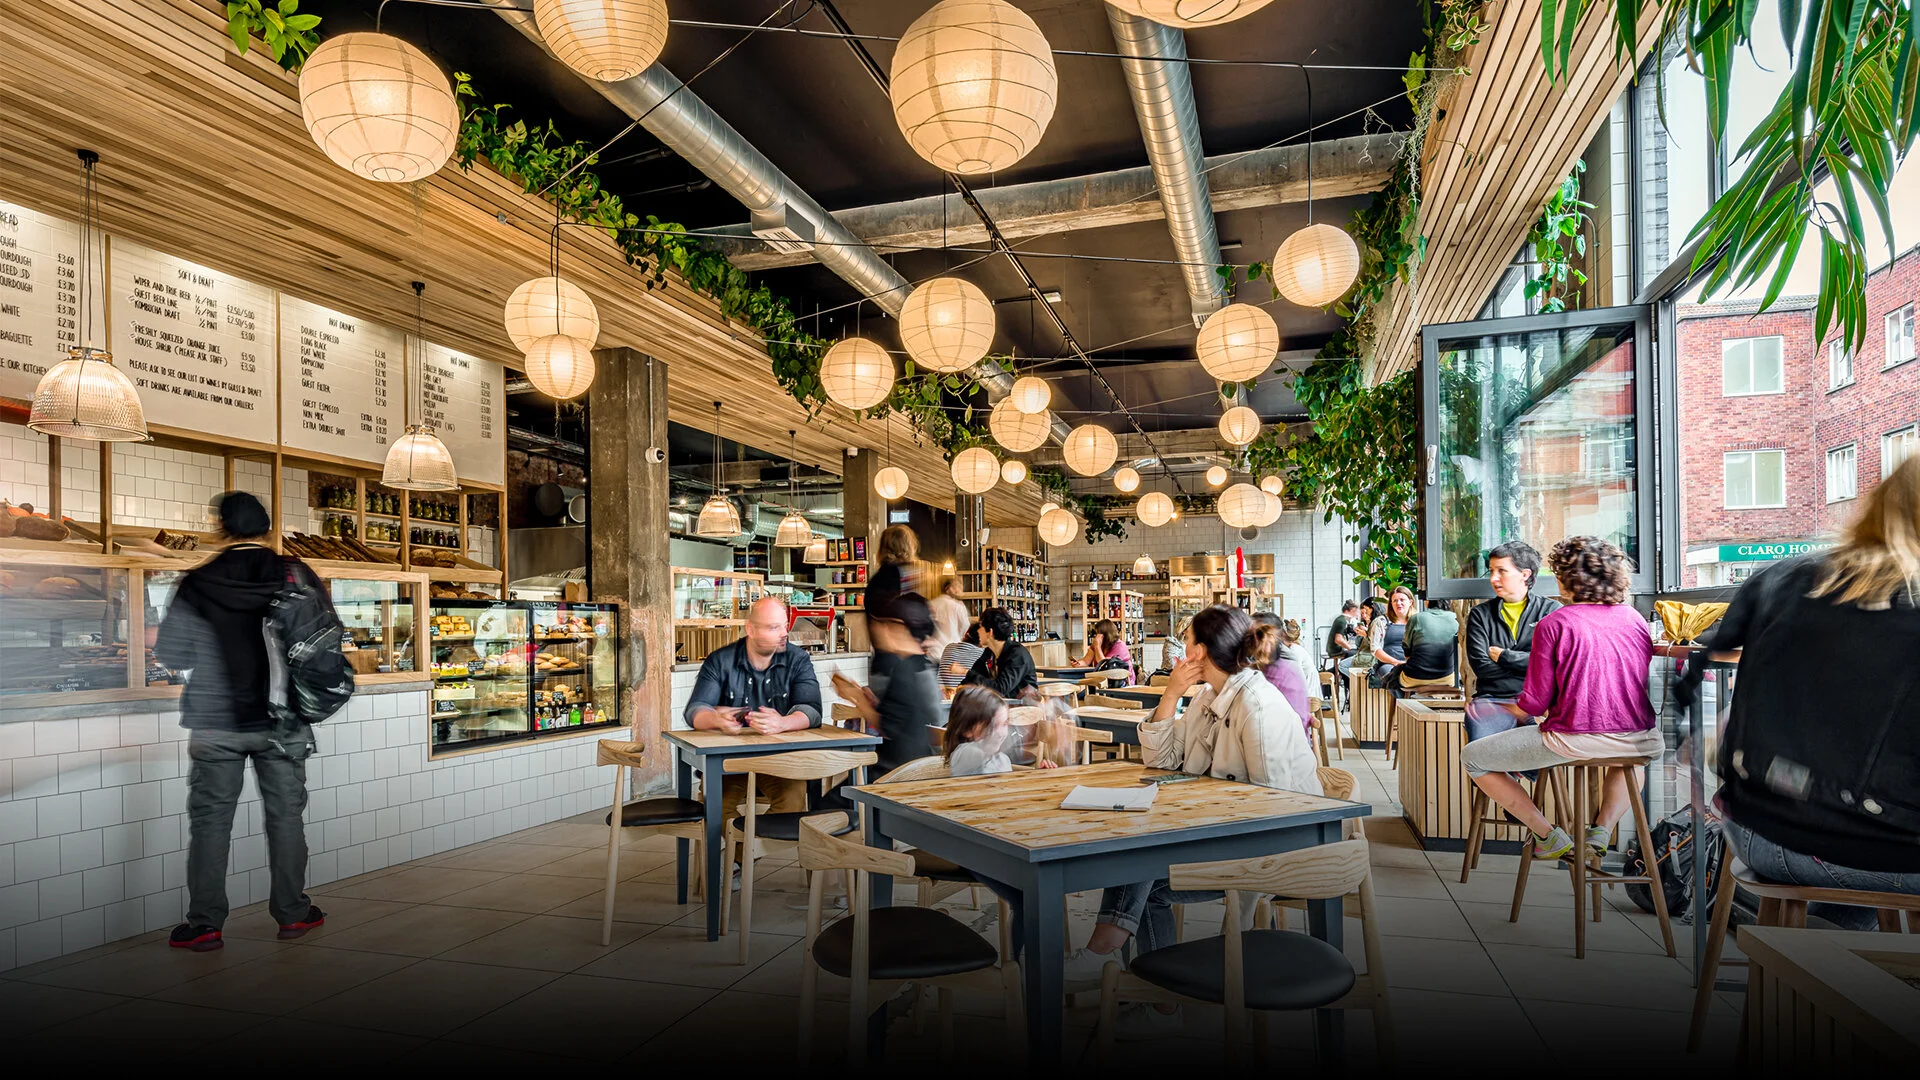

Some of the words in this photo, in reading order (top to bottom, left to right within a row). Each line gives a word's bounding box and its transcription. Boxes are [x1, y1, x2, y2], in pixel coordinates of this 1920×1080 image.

[0, 211, 18, 226] READ
[0, 235, 17, 249] OUGH
[58, 253, 75, 266] £3.60
[1, 249, 32, 267] OURDOUGH
[57, 266, 75, 279] £3.60
[0, 263, 18, 276] SEED
[58, 279, 75, 291] £3.70
[178, 269, 191, 281] SOFT
[198, 276, 214, 288] DRAFT
[58, 291, 76, 304] £3.70
[133, 275, 151, 289] WIPER
[152, 282, 164, 292] AND
[166, 285, 177, 296] TRUE
[179, 289, 191, 301] BEER
[134, 287, 150, 301] GUEST
[153, 292, 166, 305] BEER
[167, 296, 178, 309] LINE
[1, 303, 20, 317] WHITE
[57, 317, 75, 329] £2.70
[57, 304, 76, 316] £3.70
[134, 300, 162, 316] KOMBUCHA
[164, 307, 181, 320] DRAFT
[0, 329, 33, 346] BAGUETTE
[134, 324, 157, 338] FRESHLY
[160, 331, 184, 344] SQUEEZED
[186, 338, 206, 351] ORANGE
[208, 343, 221, 354] JUICE
[241, 352, 256, 363] £3.50
[300, 325, 317, 338] DOUBLE
[319, 331, 340, 344] ESPRESSO
[300, 336, 313, 347] LONG
[314, 340, 327, 351] BLACK
[134, 336, 152, 349] HOUSE
[197, 351, 208, 362] ASK
[300, 345, 311, 355] FLAT
[7, 359, 20, 371] OUR
[129, 359, 148, 372] PLEASE
[149, 364, 159, 374] ASK
[161, 366, 166, 376] TO
[167, 368, 176, 378] SEE
[177, 371, 187, 381] OUR
[187, 373, 198, 383] LIST
[199, 376, 205, 384] OF
[206, 378, 220, 388] WINES
[228, 383, 241, 393] GLASS
[247, 387, 262, 397] DRAFT
[302, 378, 315, 389] GUEST
[136, 377, 149, 388] SOFT
[150, 381, 170, 392] DRINKS
[171, 386, 181, 395] ARE
[183, 388, 208, 401] AVAILABLE
[210, 394, 223, 404] FROM
[223, 397, 233, 406] OUR
[234, 399, 254, 410] CHILLERS
[302, 398, 316, 409] GUEST
[319, 402, 340, 414] ESPRESSO
[1737, 545, 1785, 555] CLARO
[1788, 543, 1837, 554] HOME
